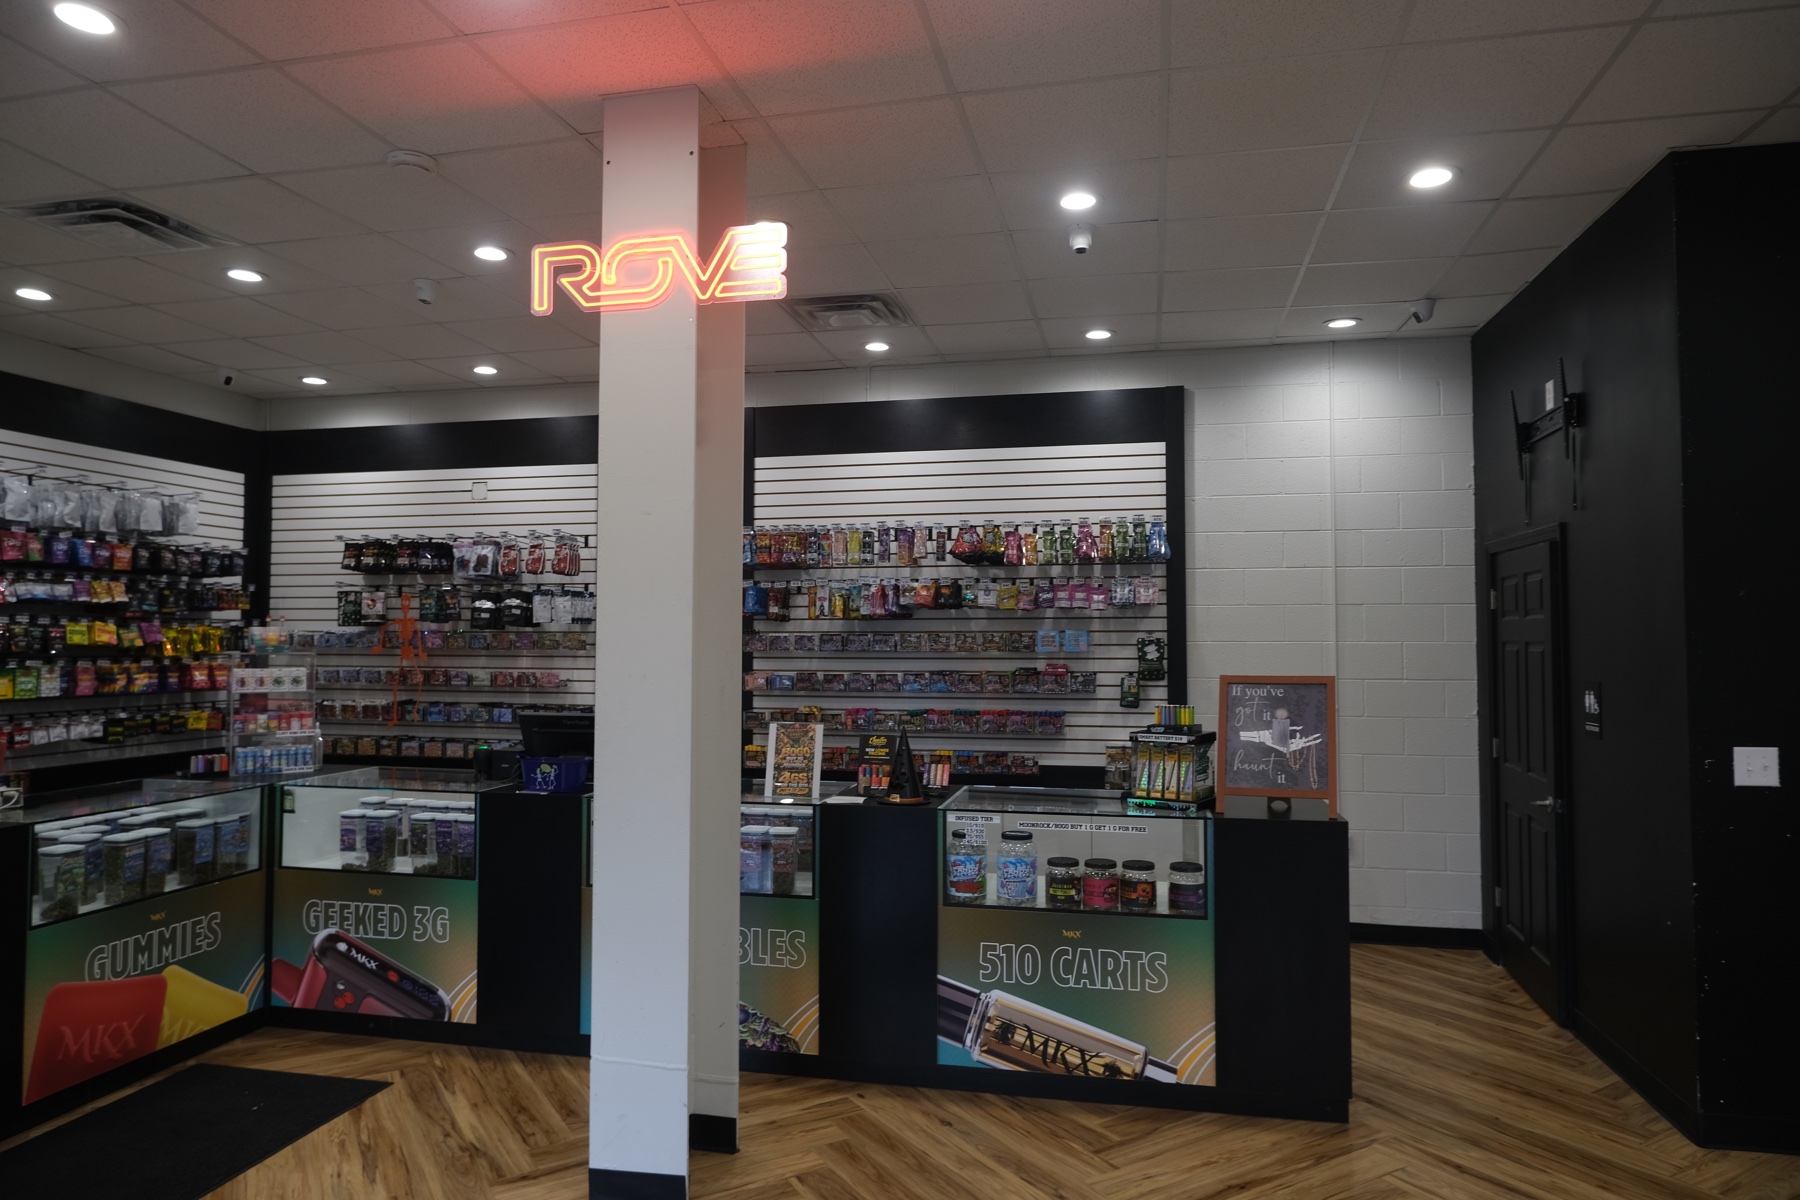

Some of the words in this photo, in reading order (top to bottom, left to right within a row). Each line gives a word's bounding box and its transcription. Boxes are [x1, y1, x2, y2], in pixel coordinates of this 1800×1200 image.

[531, 222, 788, 317] ROVE
[1232, 685, 1241, 696] If
[1244, 685, 1285, 699] you've
[1234, 697, 1270, 727] got
[1263, 709, 1272, 721] it
[781, 747, 811, 757] BOGO
[1233, 749, 1287, 779] haunt
[1277, 771, 1286, 784] it
[303, 899, 407, 940] GEEKED
[413, 905, 450, 943] 3G
[85, 911, 222, 983] GUMMIES
[350, 948, 380, 971] MKX
[979, 941, 1042, 986] 510
[1050, 945, 1168, 994] CARTS
[57, 1012, 147, 1064] MKX
[1020, 1023, 1104, 1076] MKX
